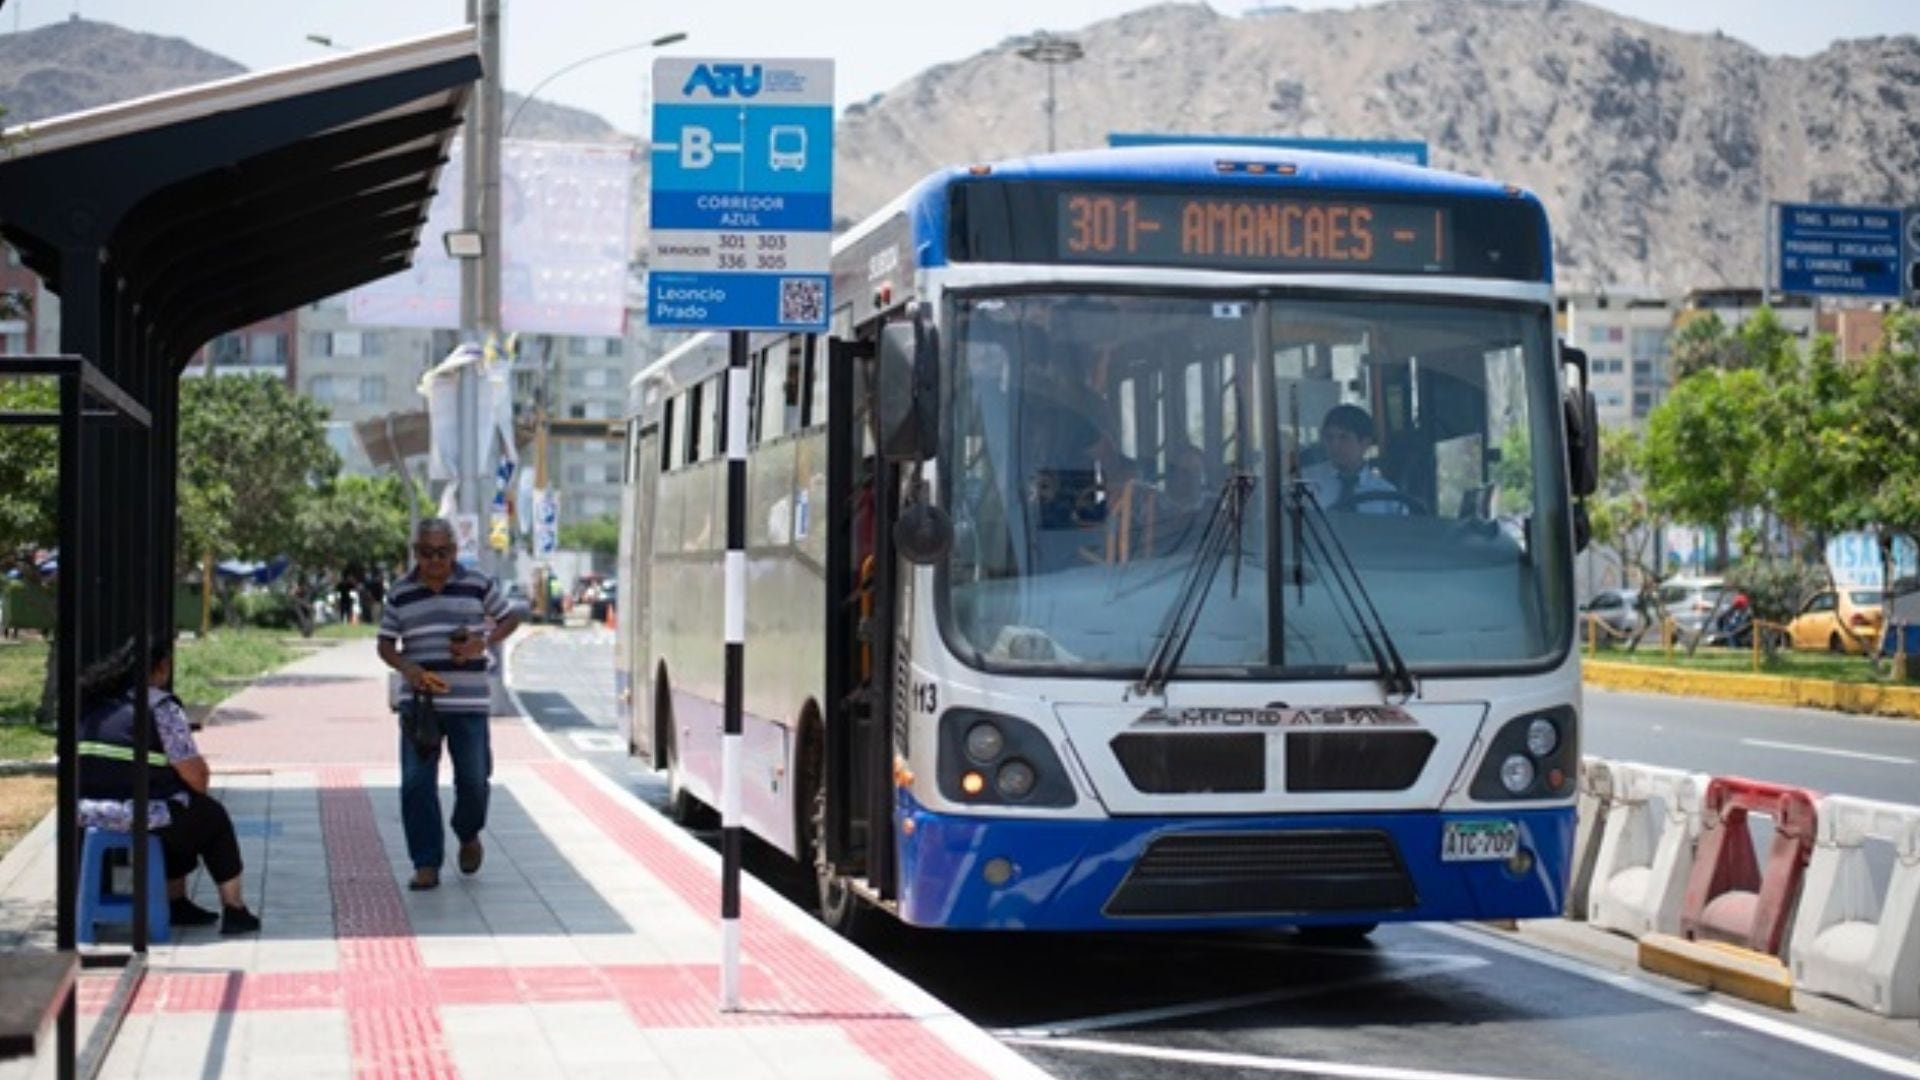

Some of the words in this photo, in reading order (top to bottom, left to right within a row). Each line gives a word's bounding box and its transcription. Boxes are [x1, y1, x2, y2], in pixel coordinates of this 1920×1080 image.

[683, 64, 763, 98] ATU
[680, 125, 714, 169] B
[697, 196, 784, 210] CORREDOR
[720, 213, 760, 226] AZUL
[1068, 197, 1161, 252] 301-
[1182, 202, 1373, 260] AMANCAES
[718, 235, 745, 248] 301
[757, 235, 787, 249] 303
[718, 254, 746, 269] 336
[757, 255, 787, 269] 305
[657, 286, 726, 302] Leoncio
[657, 303, 708, 319] Prado
[913, 682, 938, 715] 113
[1446, 829, 1515, 855] ATC-709
